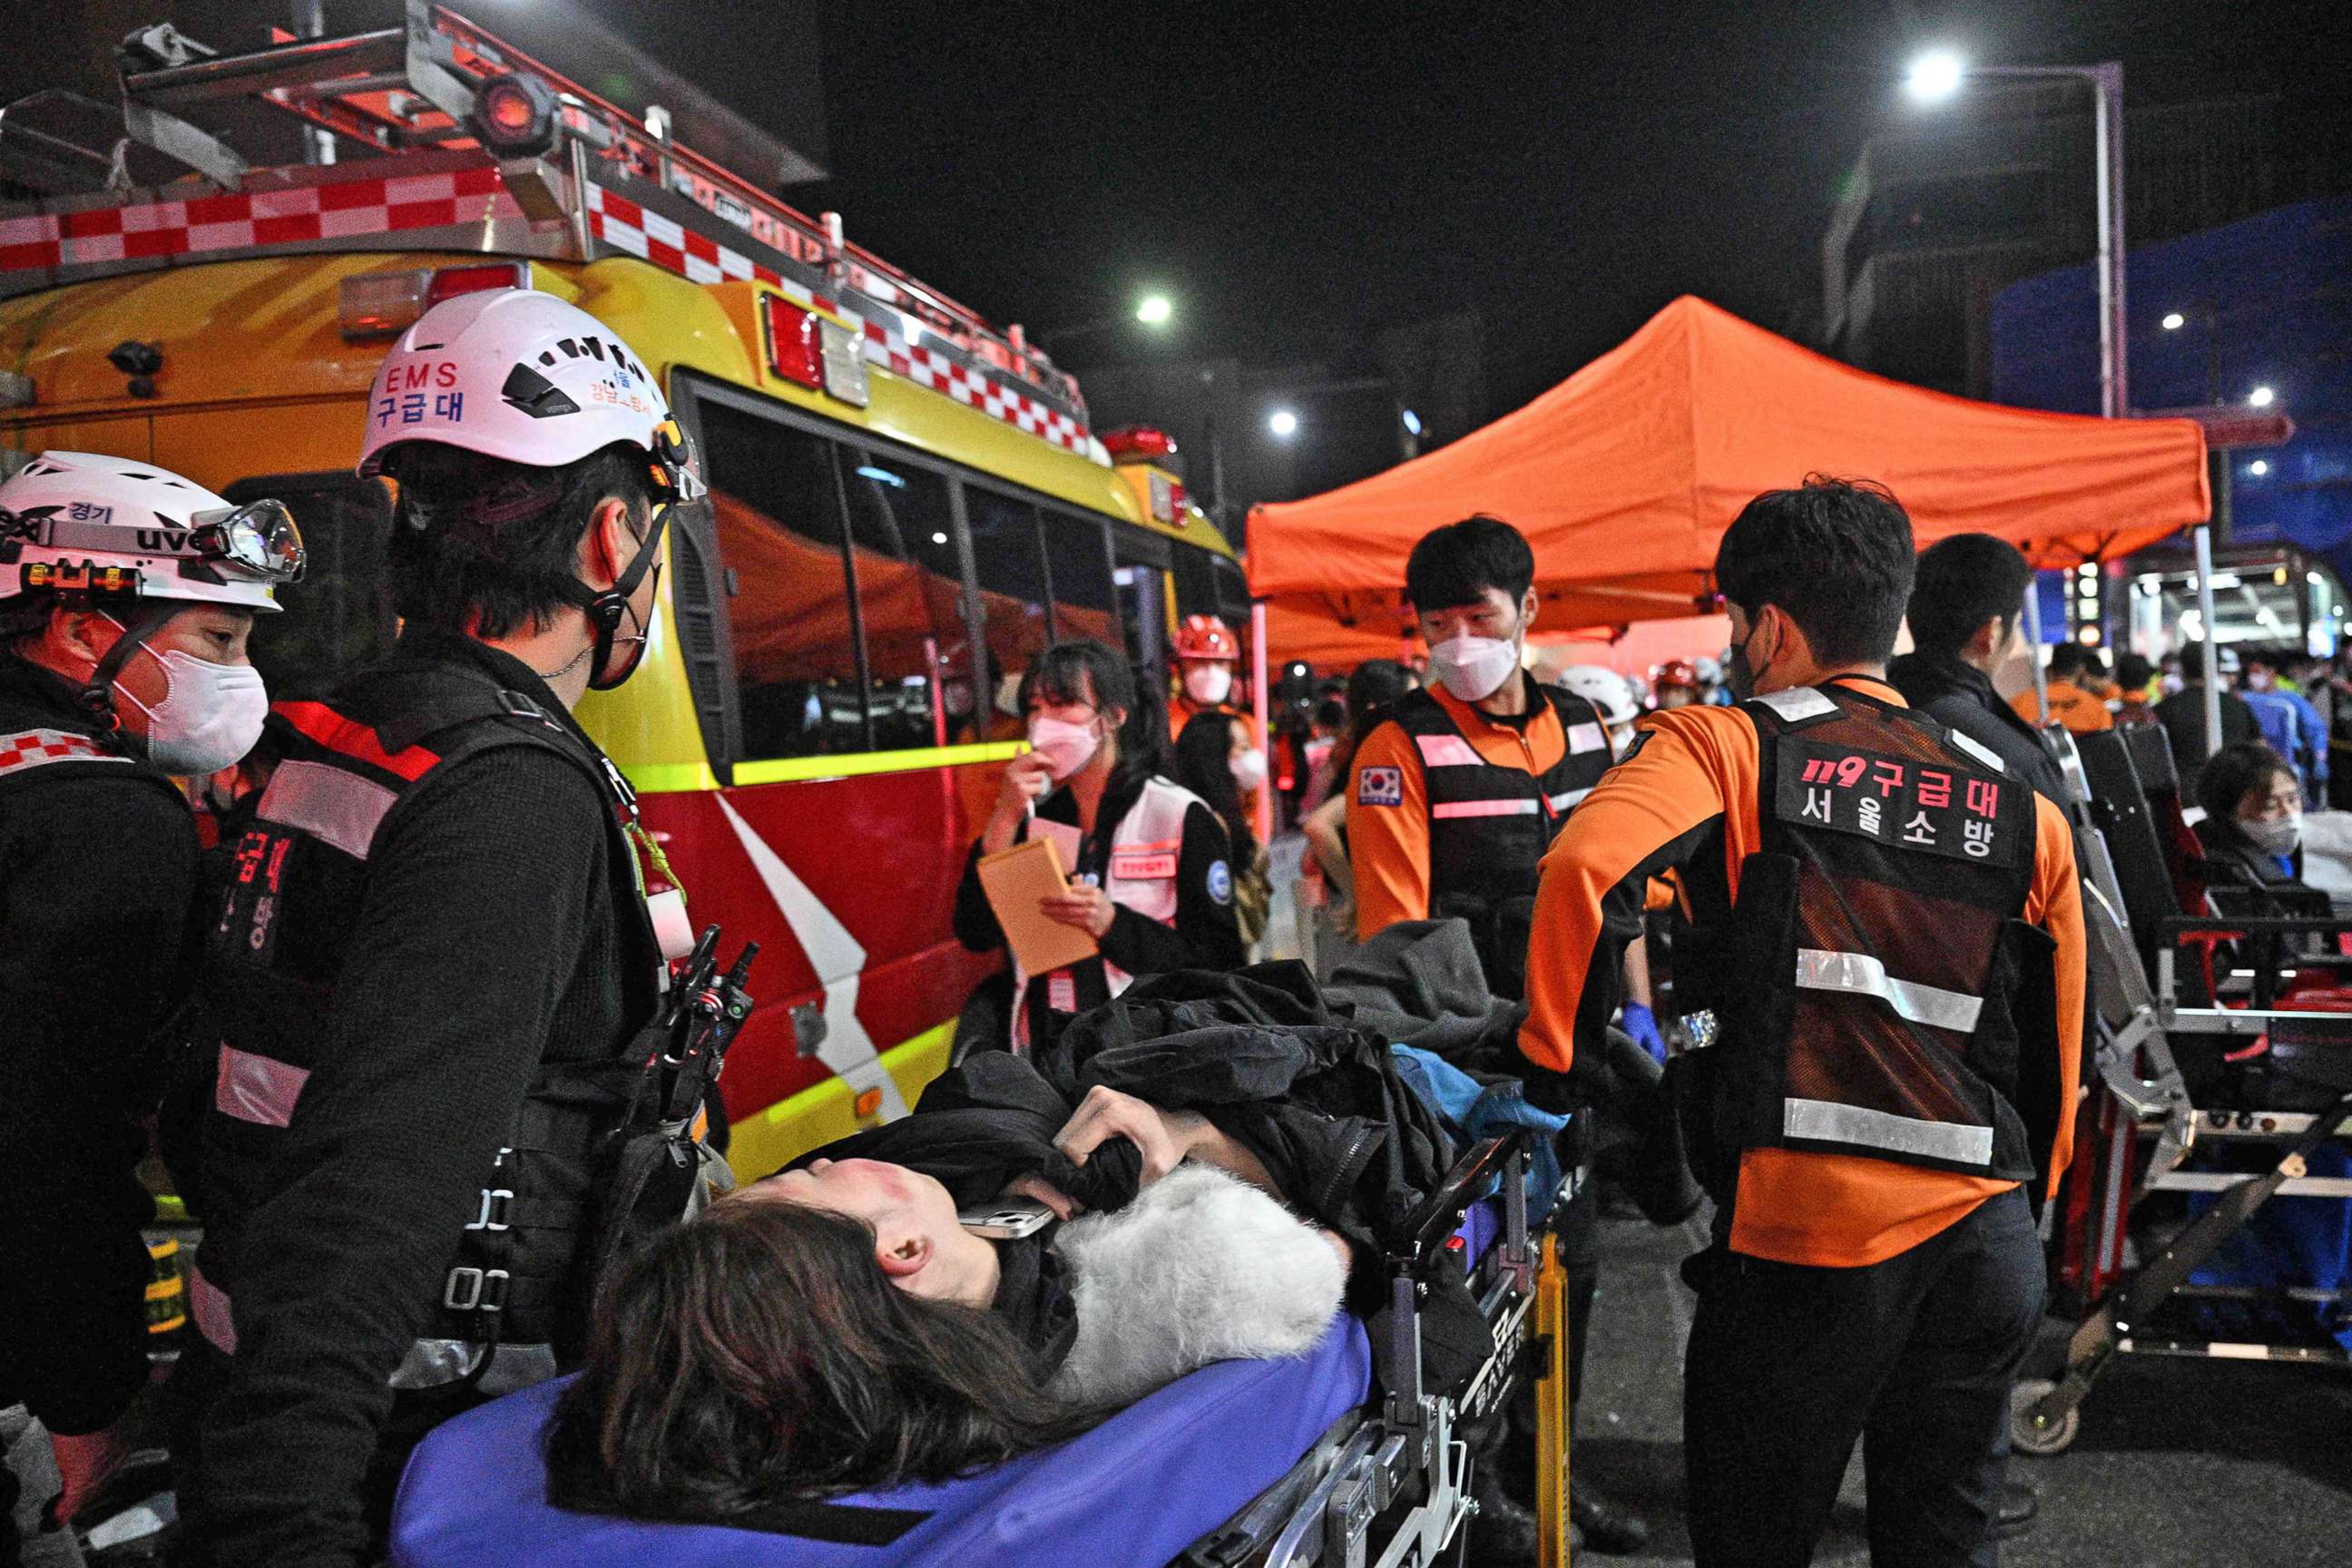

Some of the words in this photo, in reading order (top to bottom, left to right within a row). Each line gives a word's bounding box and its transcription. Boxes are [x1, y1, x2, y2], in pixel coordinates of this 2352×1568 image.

[386, 362, 457, 394] EMS
[377, 391, 464, 428] 구급대
[70, 502, 113, 524] 경기
[1799, 755, 2000, 820] 119구급대
[1800, 787, 1995, 858] 서울소방
